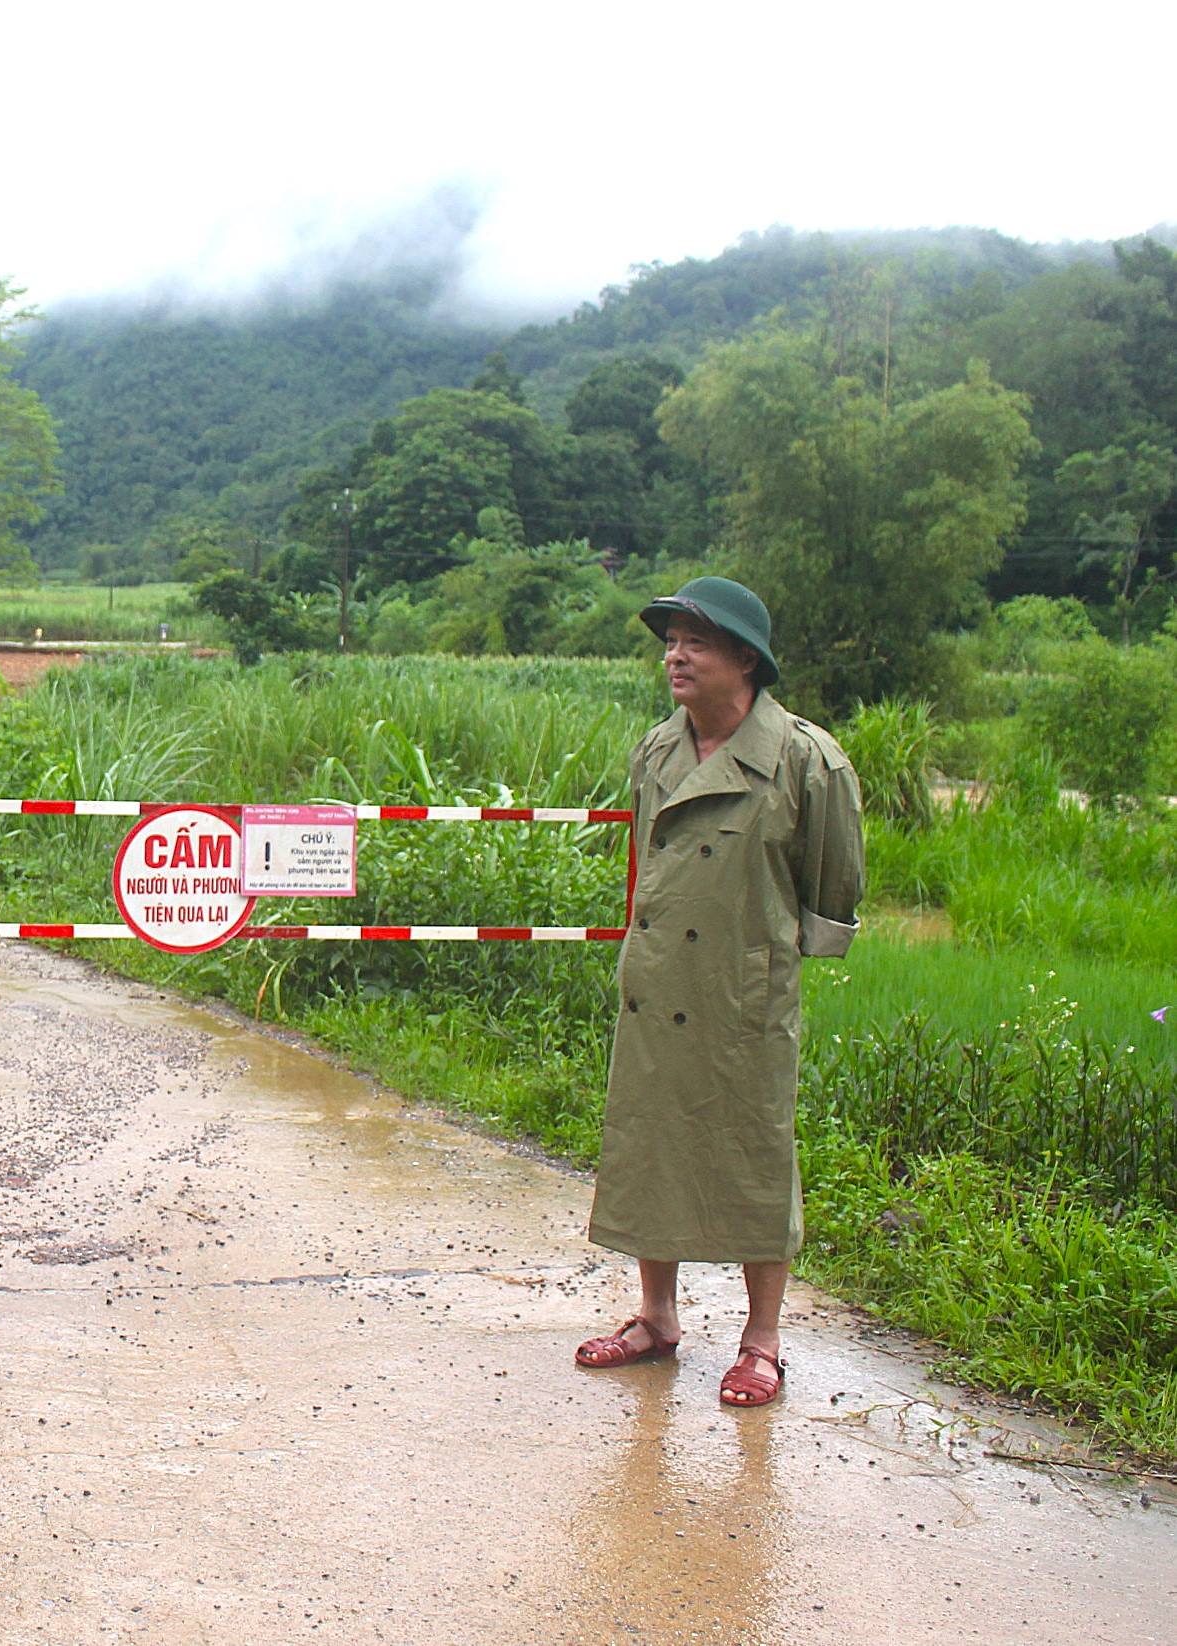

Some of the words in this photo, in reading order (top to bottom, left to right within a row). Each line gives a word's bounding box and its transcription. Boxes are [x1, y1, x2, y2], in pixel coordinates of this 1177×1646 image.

[144, 822, 232, 869] CẤM
[126, 873, 168, 895] NGƯỜI
[172, 873, 189, 895] VÀ
[144, 902, 173, 926] TIỆN
[178, 906, 205, 924] QUA
[208, 905, 229, 926] LẠI
